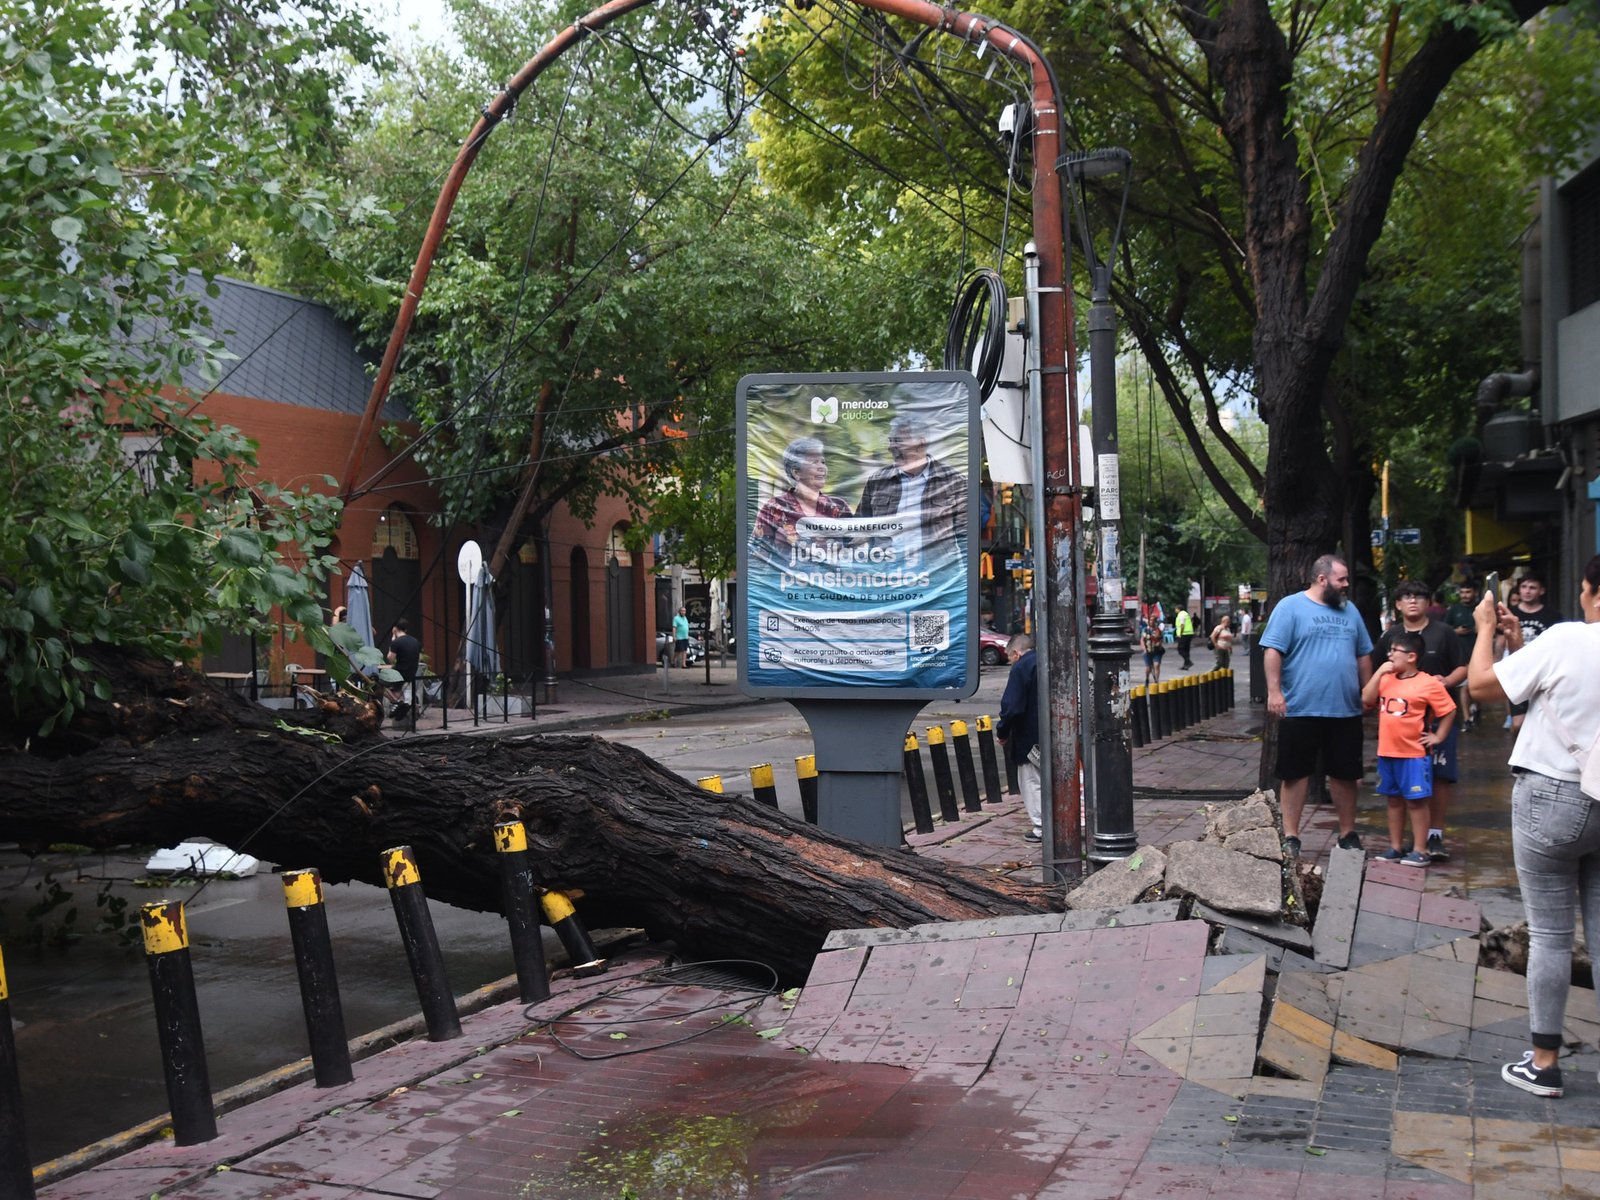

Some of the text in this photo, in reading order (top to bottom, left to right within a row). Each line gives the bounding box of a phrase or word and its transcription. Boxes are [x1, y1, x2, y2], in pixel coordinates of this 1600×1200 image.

[841, 399, 889, 409] mendoza
[841, 410, 874, 420] ciudad
[805, 523, 904, 531] NUEVOS BENEFICIOS
[789, 541, 897, 567] jubilados
[780, 567, 930, 592] pensionados
[787, 592, 800, 600] DE
[804, 592, 816, 600] LA
[820, 592, 856, 600] CIUDAD
[860, 593, 873, 601] DE
[1311, 615, 1349, 627] MALIBU
[793, 648, 818, 656] Acceso
